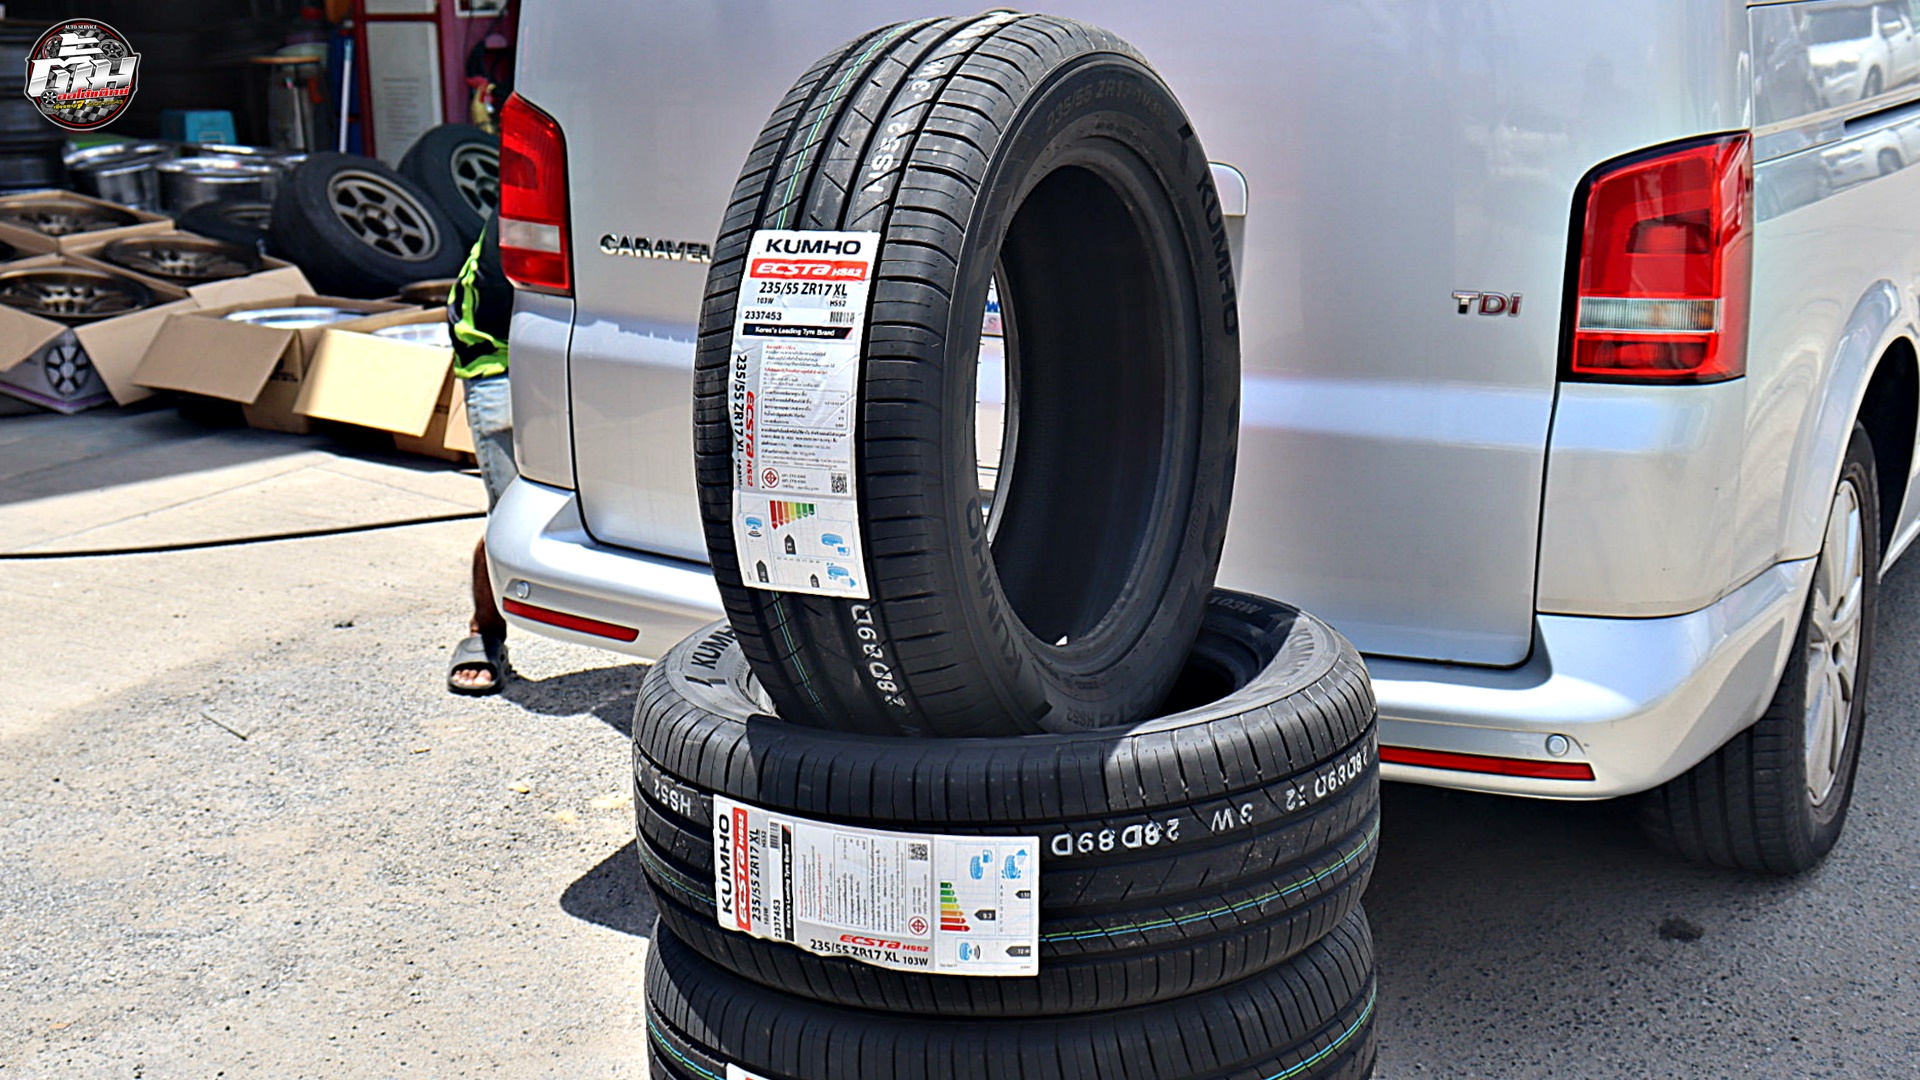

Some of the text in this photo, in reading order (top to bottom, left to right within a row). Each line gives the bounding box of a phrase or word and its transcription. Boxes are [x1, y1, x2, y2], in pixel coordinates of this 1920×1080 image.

[868, 121, 910, 193] HS52
[765, 238, 861, 255] KUMHO
[1196, 170, 1238, 336] KUMHO
[759, 281, 848, 297] 235/55 ZR17 XL
[829, 300, 846, 308] HS52
[1451, 290, 1523, 317] TDI
[744, 310, 782, 321] 2337453
[754, 326, 835, 337] Korea's Leading Tyre Brand
[733, 355, 747, 400] 235/55
[733, 403, 745, 436] ZR17
[965, 496, 1023, 681] KUMHO
[690, 624, 738, 670] KUMH
[654, 778, 692, 818] HS52
[719, 813, 732, 914] KUMHO
[749, 828, 761, 922] 235/55 ZR17 XL
[784, 880, 792, 904] Leading
[773, 899, 782, 939] 2337453
[810, 938, 929, 966] 235/55 ZR17 XL 103W
[902, 944, 929, 953] HS52
